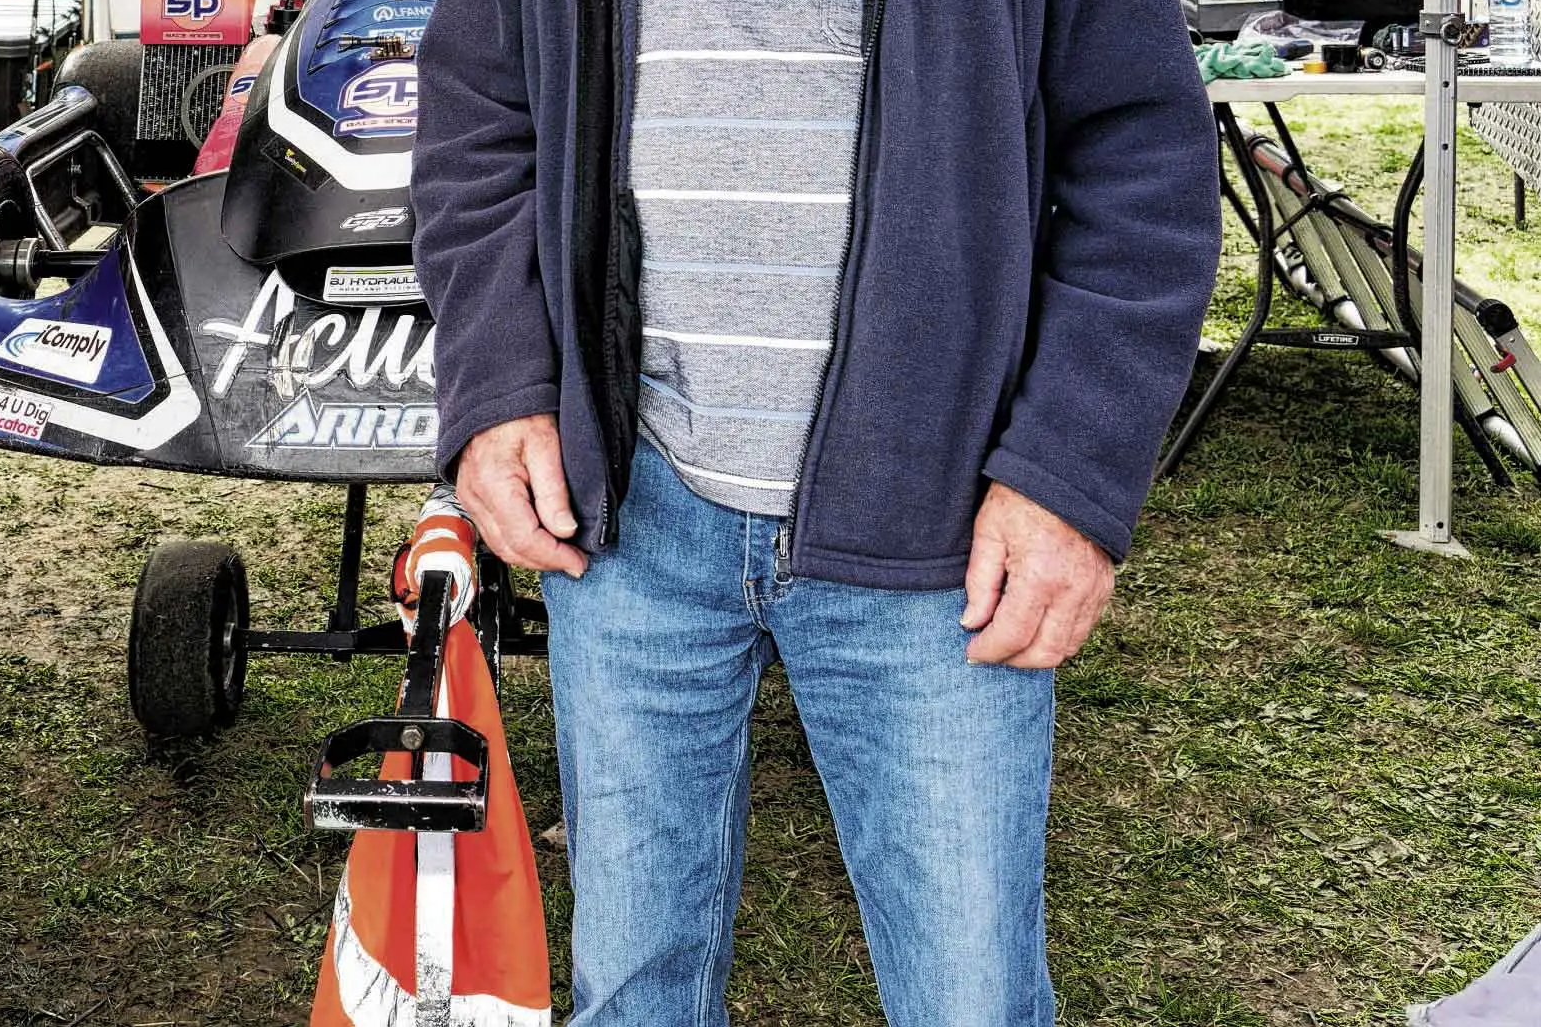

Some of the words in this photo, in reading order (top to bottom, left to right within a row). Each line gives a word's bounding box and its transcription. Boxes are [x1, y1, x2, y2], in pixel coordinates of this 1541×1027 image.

[35, 324, 107, 362] iComply
[10, 400, 24, 414] U
[25, 402, 50, 426] Dig
[246, 389, 440, 450] ARRO
